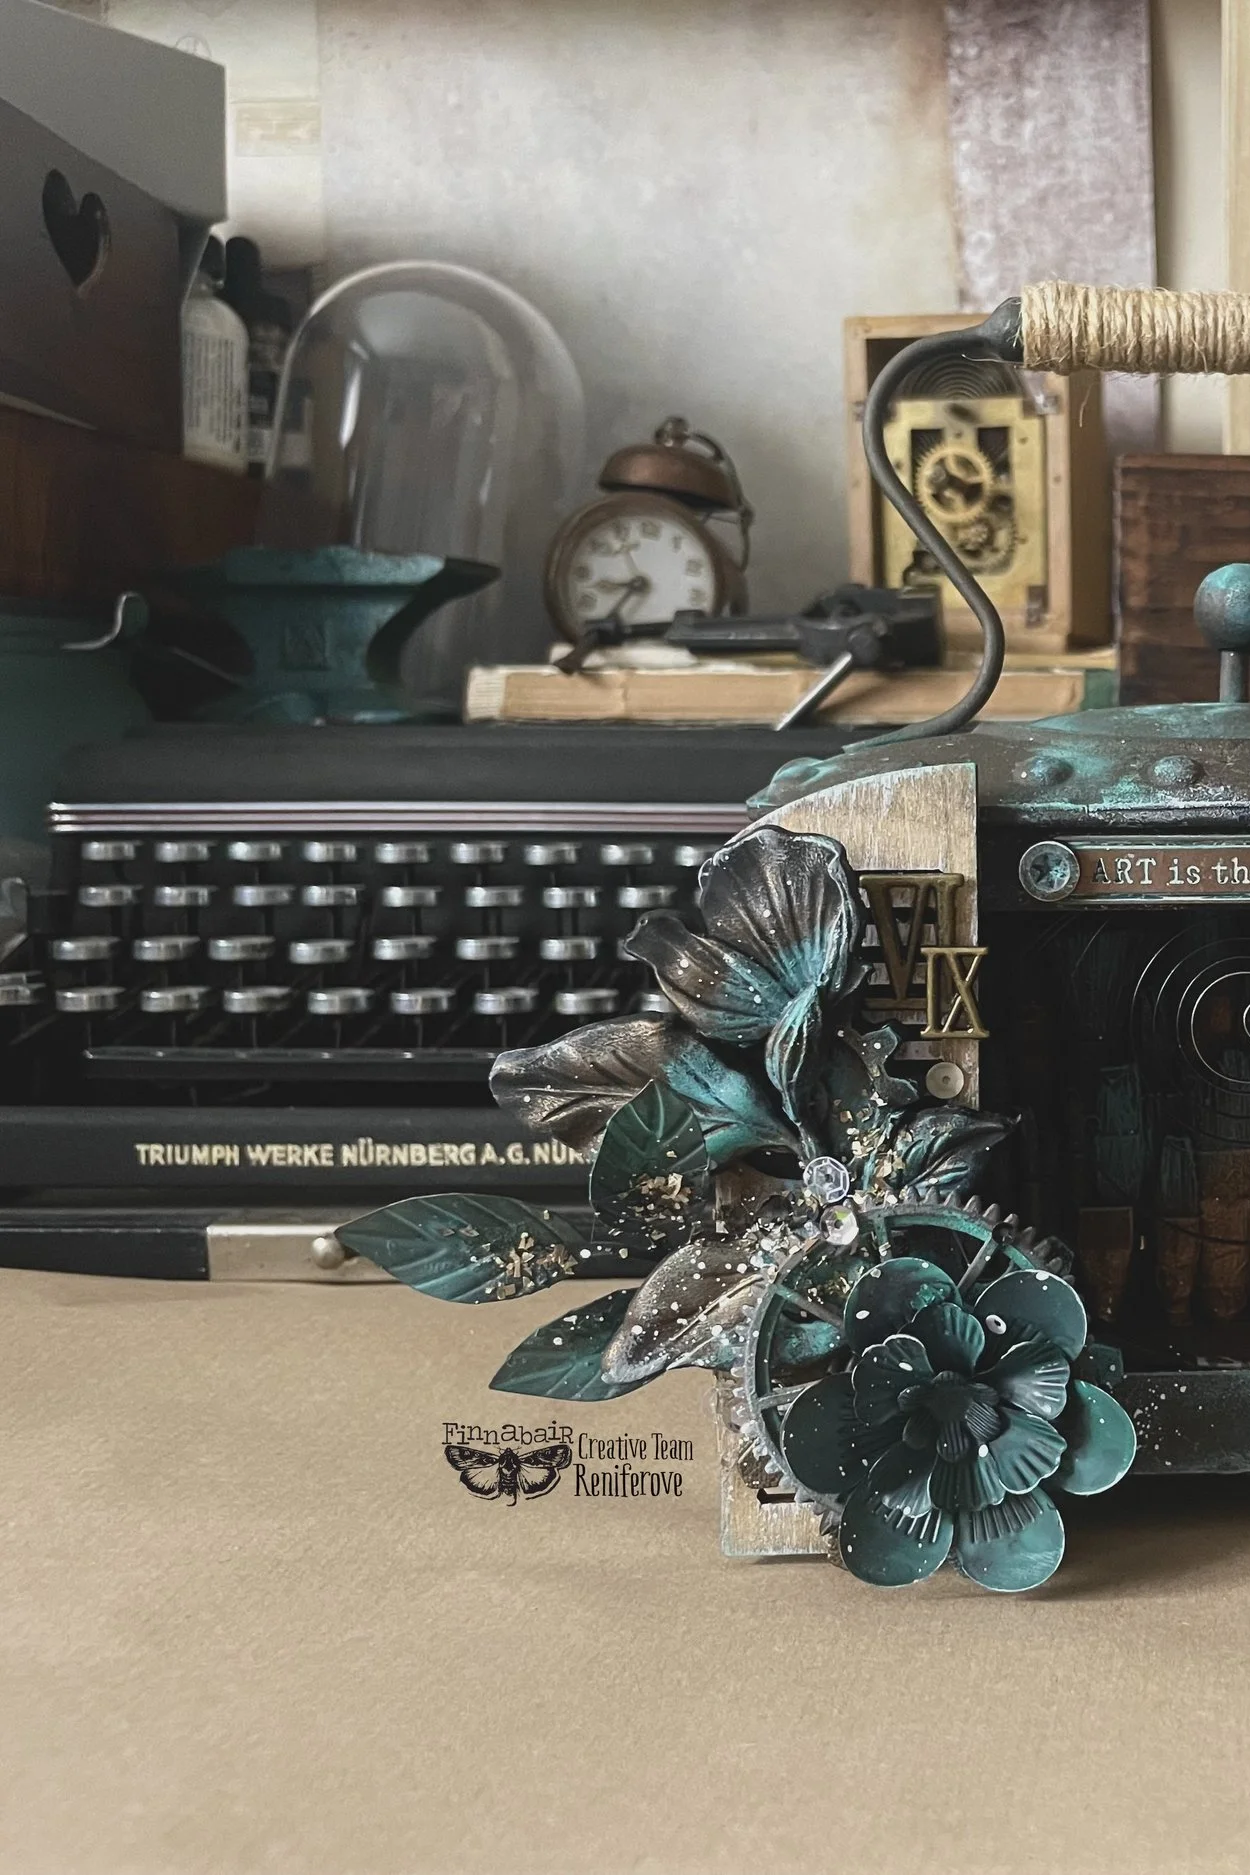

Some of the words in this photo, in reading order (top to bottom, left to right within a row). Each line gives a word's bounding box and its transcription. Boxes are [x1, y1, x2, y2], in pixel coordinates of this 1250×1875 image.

[1092, 856, 1157, 885] ART
[1167, 856, 1200, 885] is
[135, 1143, 240, 1167] TRIUMPH
[247, 1143, 334, 1167] WERKE
[341, 1138, 476, 1167] NÜRNBERG
